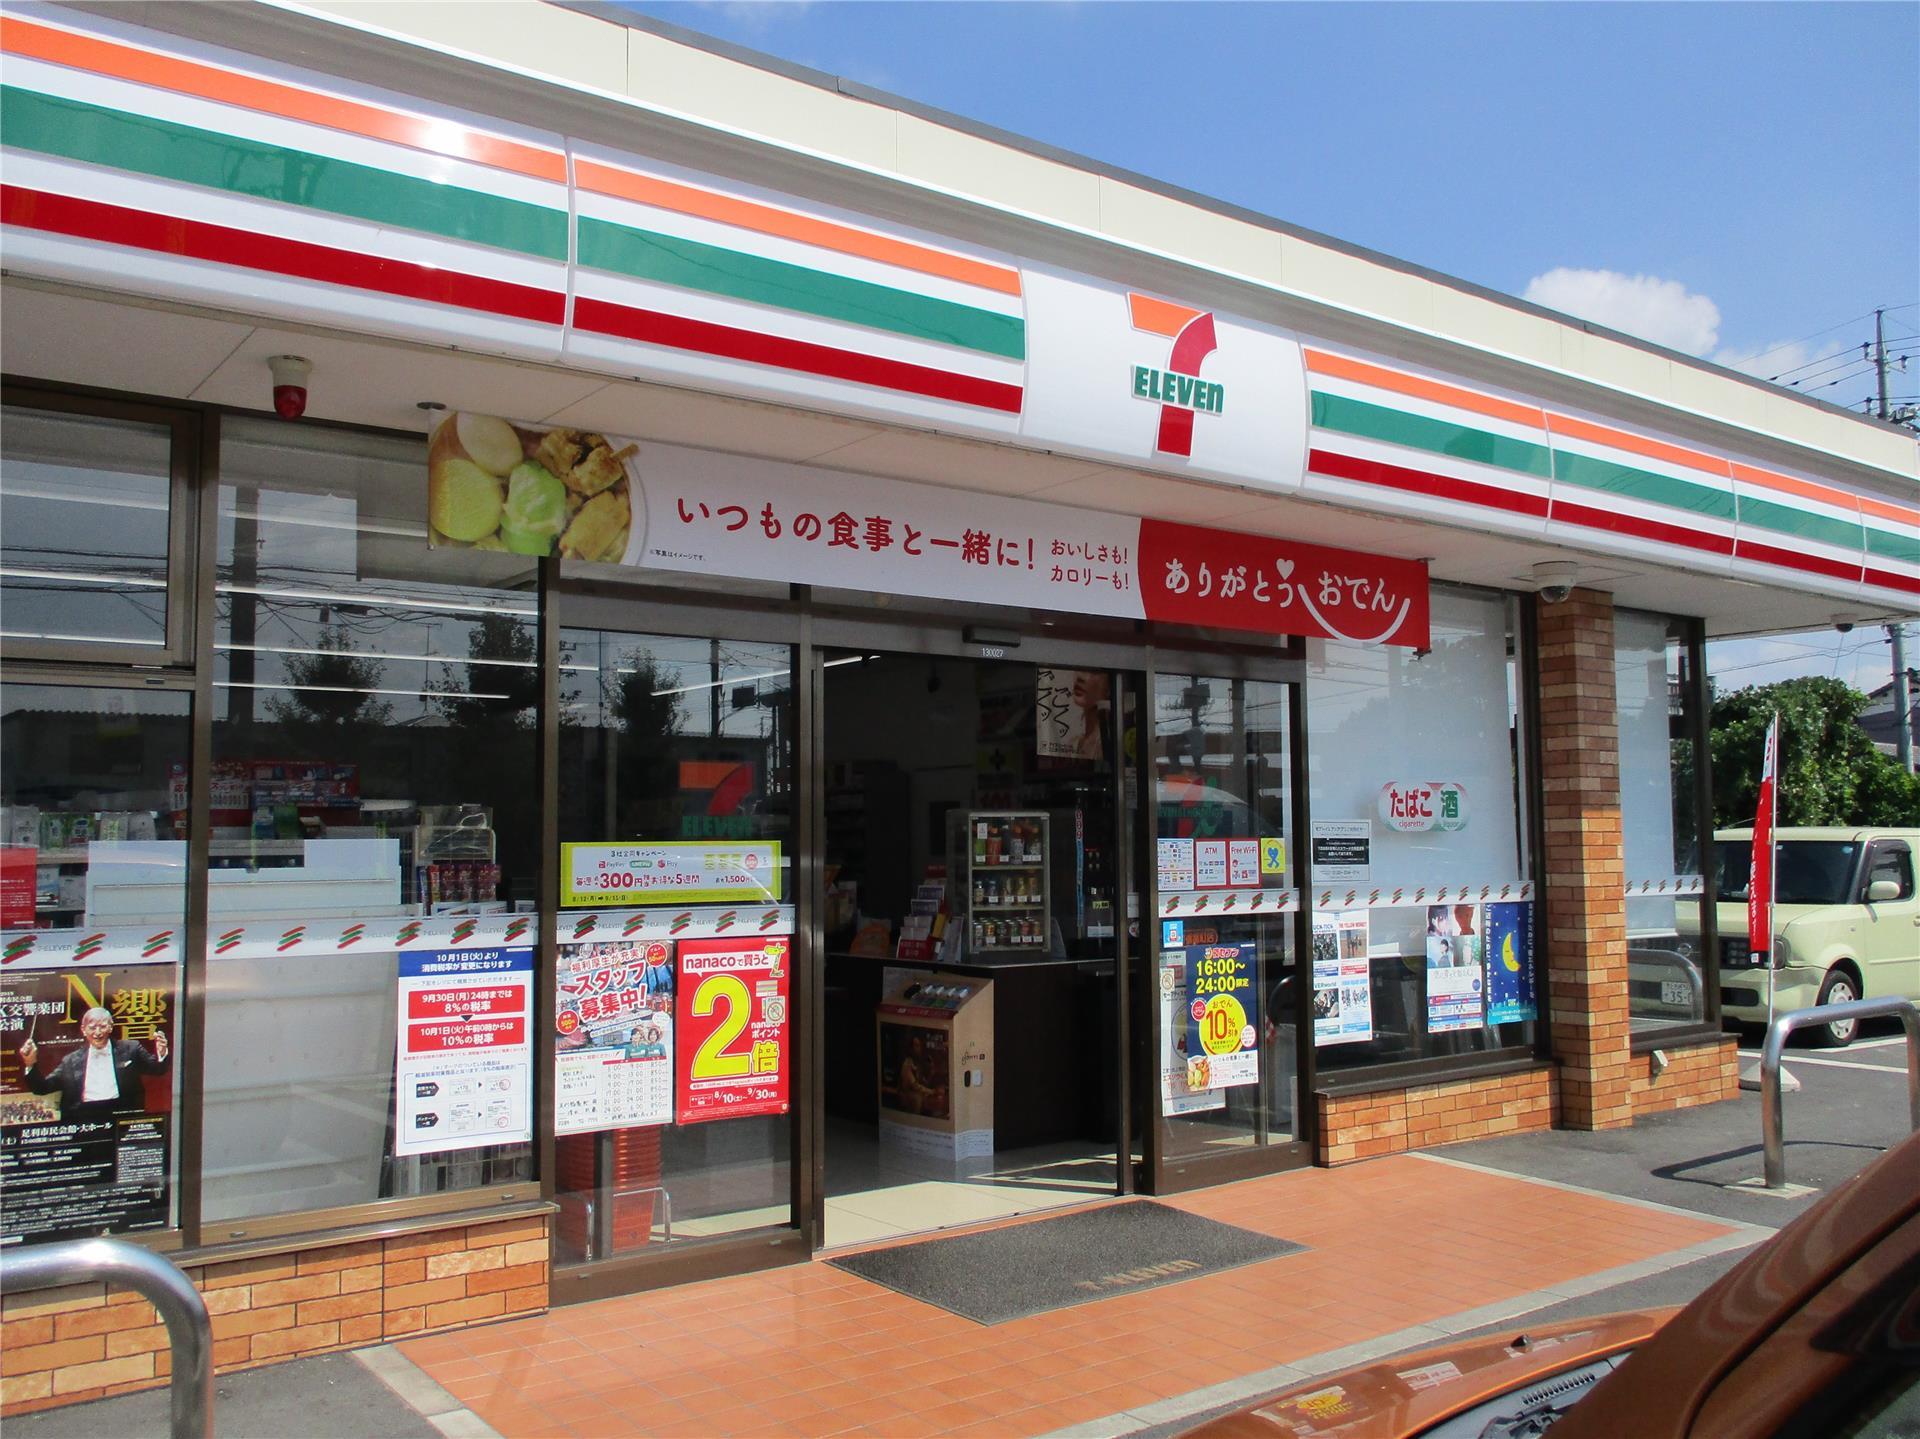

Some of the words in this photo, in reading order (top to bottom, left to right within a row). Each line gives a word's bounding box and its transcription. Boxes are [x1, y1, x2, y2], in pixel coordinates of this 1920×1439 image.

[1127, 292, 1218, 457] 7
[676, 497, 1035, 570] いつもの食事と一緒に!
[1050, 538, 1129, 565] おいしさも!
[1050, 564, 1130, 591] カロリーも!
[1318, 570, 1396, 613] おでん
[1390, 788, 1433, 818] たばこ
[1440, 790, 1458, 818] 酒
[1398, 820, 1424, 829] cigarette
[1204, 847, 1218, 855] ATM
[575, 960, 647, 997] スタッフ
[444, 1002, 492, 1014] 8%の税率
[579, 983, 648, 1023] 募集中!
[1212, 1000, 1233, 1009] おでん
[441, 1033, 494, 1046] 10%の税率
[751, 1028, 780, 1039] ポイント
